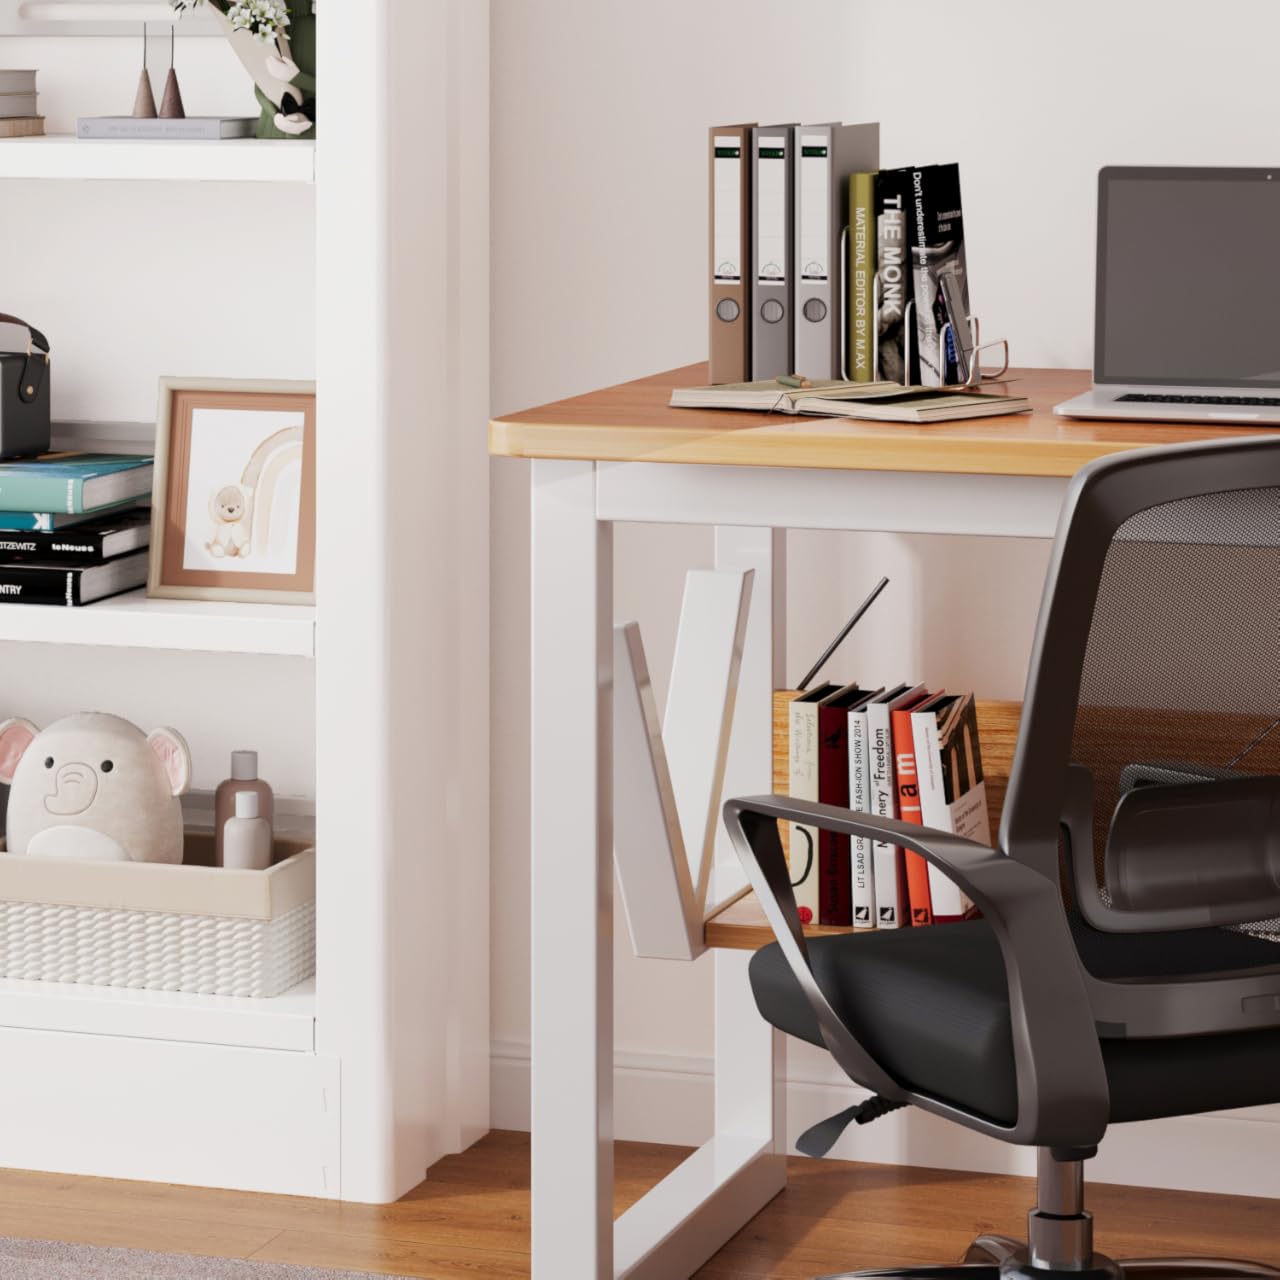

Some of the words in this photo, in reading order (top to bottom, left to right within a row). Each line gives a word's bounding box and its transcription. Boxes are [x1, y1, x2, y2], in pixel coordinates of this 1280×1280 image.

[912, 172, 922, 197] Don't
[883, 194, 902, 240] THE
[855, 207, 866, 267] MATERIAL
[914, 198, 927, 265] underestimate
[855, 270, 866, 316] EDITOR
[883, 246, 902, 317] MONK
[855, 320, 866, 336] BY
[853, 720, 862, 738] 2014
[854, 739, 863, 764] SHOW
[872, 728, 886, 780] Freedom
[897, 753, 915, 776] m
[854, 766, 863, 804] FASH-ION
[900, 783, 918, 798] a
[856, 852, 865, 874] LSAD
[856, 876, 865, 888] LIT
